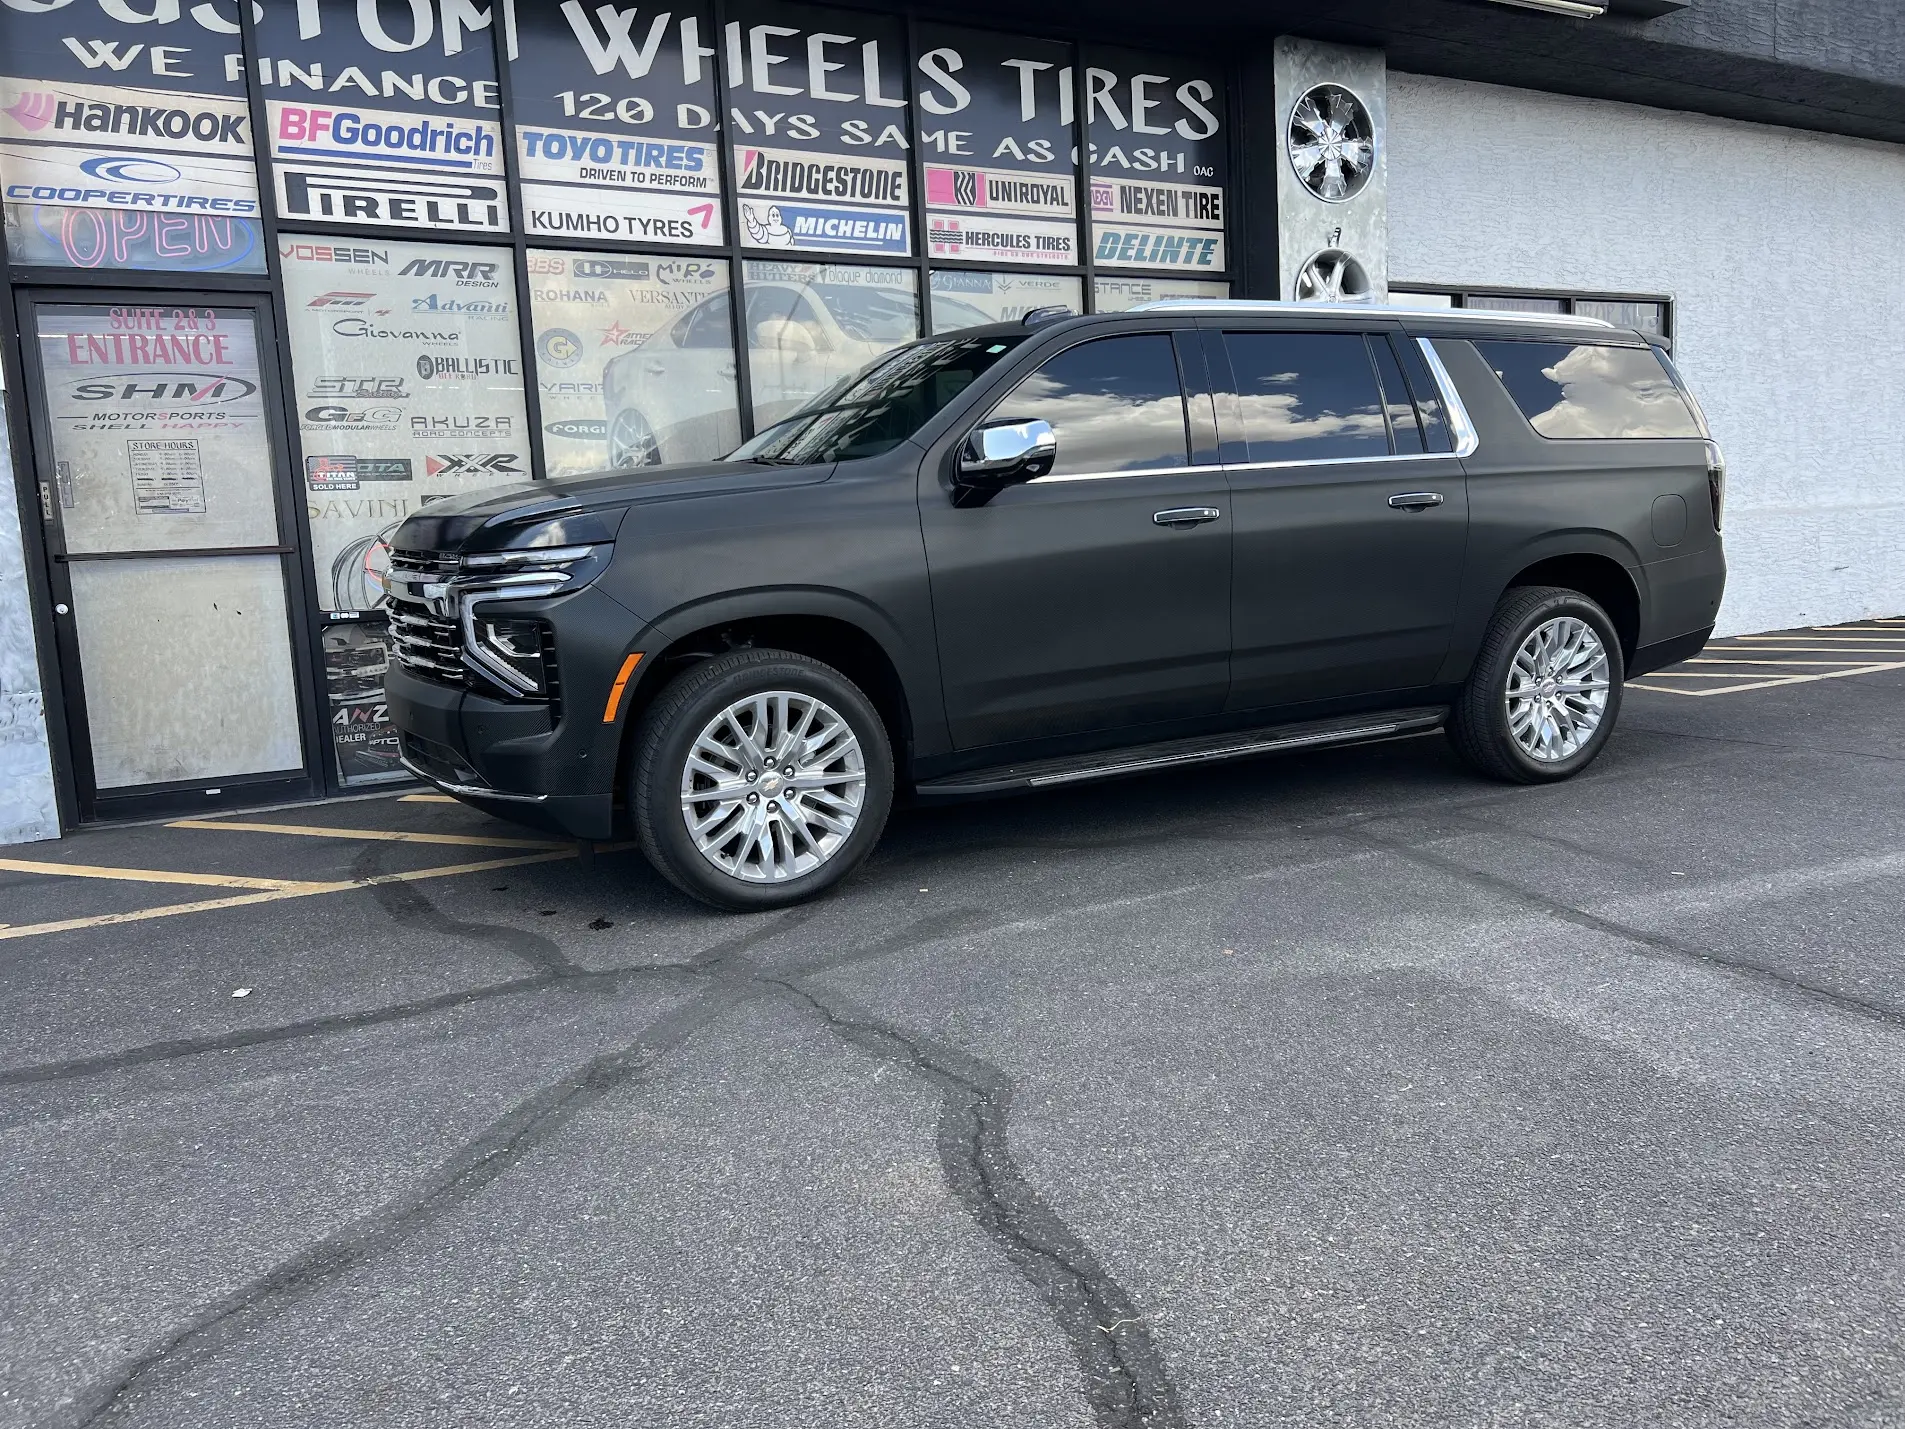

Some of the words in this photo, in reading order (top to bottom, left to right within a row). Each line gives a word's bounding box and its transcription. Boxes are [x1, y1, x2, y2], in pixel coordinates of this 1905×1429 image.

[62, 37, 194, 78] WE
[224, 54, 500, 109] FINANCE
[560, 0, 972, 115] WHEELS
[1001, 58, 1220, 141] TIRES
[279, 107, 494, 157] BFGoodrich
[553, 91, 654, 124] 120
[677, 104, 820, 139] DAYS
[840, 120, 974, 155] SAME
[992, 137, 1055, 163] AS
[1071, 143, 1185, 173] CASH
[1193, 165, 1214, 177] OAC
[472, 158, 492, 171] Tires
[741, 150, 903, 201] BRIDGESTONE
[579, 167, 626, 182] DRIVEN
[630, 171, 645, 184] TO
[649, 173, 707, 189] PERFORM
[284, 171, 498, 227] PIRELLI
[988, 179, 1069, 207] UNIROYAL
[1119, 185, 1179, 217] NEXEN
[1182, 191, 1221, 221] TIRE
[531, 210, 620, 234] KUMHO
[623, 216, 694, 238] TYRES
[794, 216, 903, 241] MICHELIN
[62, 207, 231, 268] OPEN
[965, 231, 1031, 250] HERCULES
[1034, 235, 1071, 252] TIRES
[1094, 231, 1219, 266] DELINTE
[279, 245, 389, 265] VOSSEN
[348, 268, 391, 276] WHEELS
[398, 259, 499, 281] MRR
[613, 268, 648, 276] HELO
[747, 261, 798, 273] HEAVY
[865, 267, 903, 285] diamond
[455, 280, 499, 289] DESIGN
[1018, 280, 1061, 288] VERDE
[412, 293, 509, 314] Advanti
[534, 289, 608, 303] ROHANA
[109, 307, 167, 331] SUITE
[204, 309, 216, 331] 3
[333, 318, 460, 342] Giovanna
[67, 332, 234, 366] ENTRANCE
[434, 356, 519, 377] BALLISTIC
[71, 378, 230, 401] SHM
[72, 423, 154, 431] SHELL
[161, 421, 246, 431] HAPPY
[92, 412, 226, 421] MOTORSPORTS
[411, 416, 511, 429] AKUZA
[132, 441, 161, 450] STORE
[164, 441, 194, 449] HOURS
[42, 486, 51, 516] PULL
[308, 498, 408, 519] SAVINI
